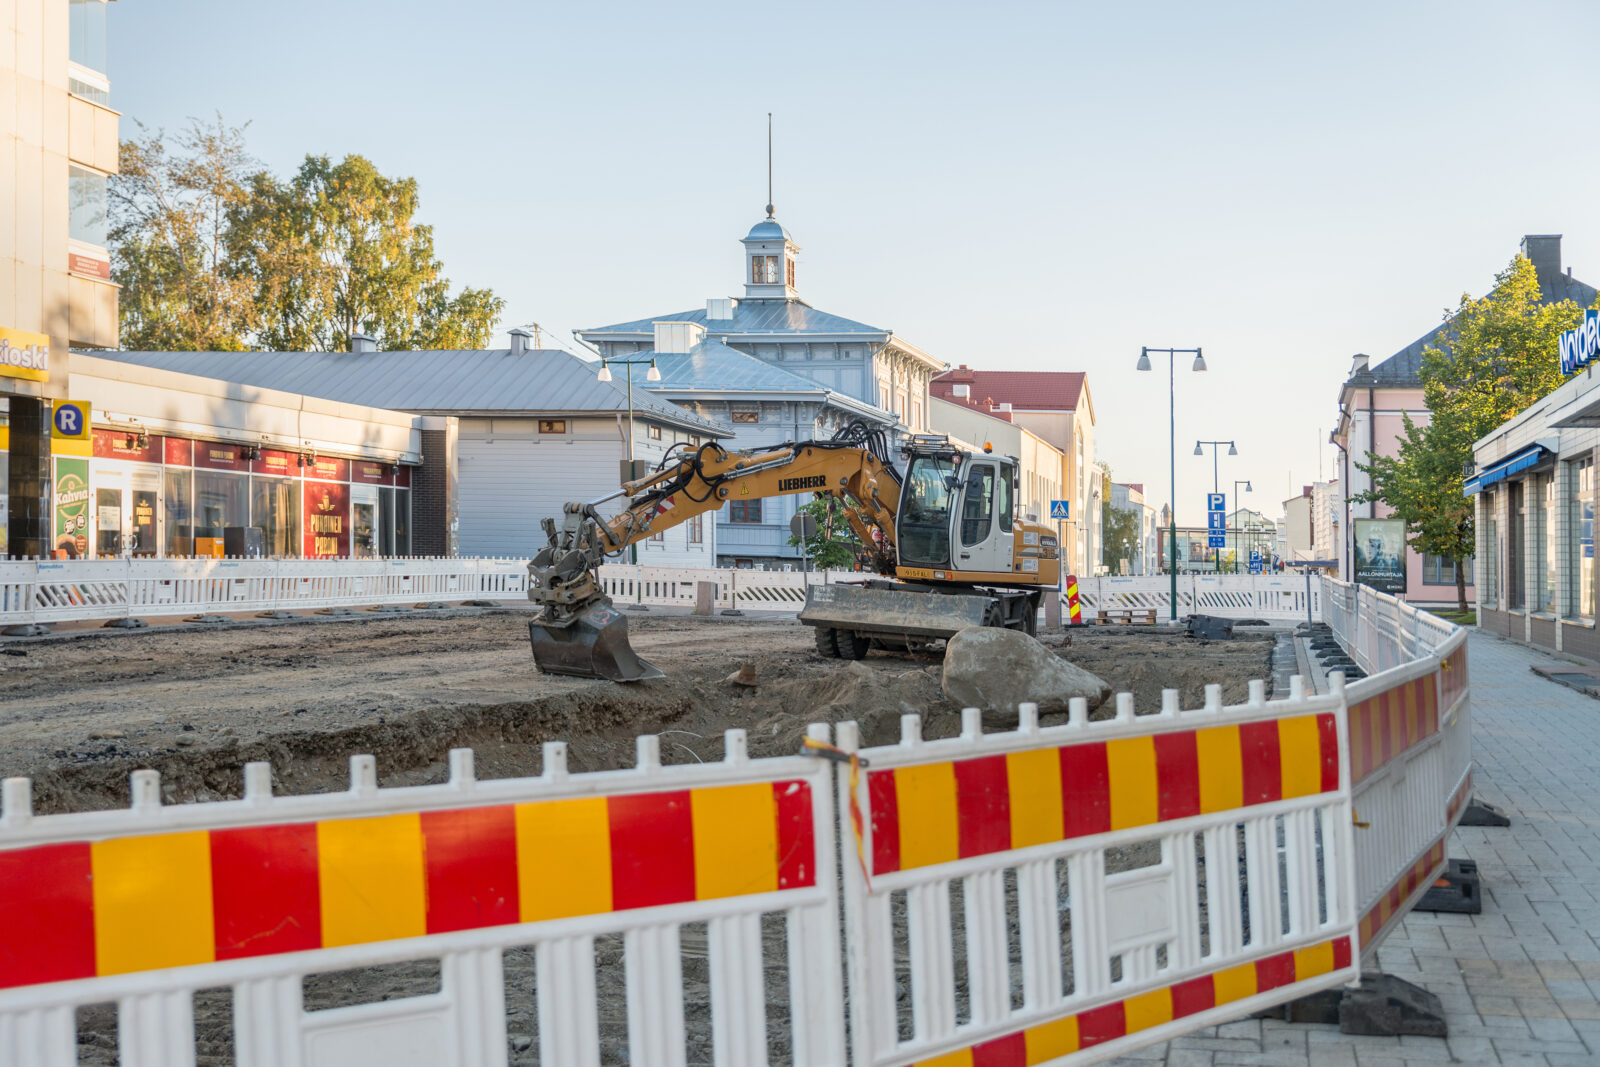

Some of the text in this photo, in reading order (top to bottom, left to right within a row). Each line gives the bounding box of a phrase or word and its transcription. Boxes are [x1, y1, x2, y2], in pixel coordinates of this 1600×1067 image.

[60, 409, 77, 430] R
[778, 474, 827, 491] LIEBHERR
[1211, 495, 1223, 510] P
[1251, 551, 1258, 560] P
